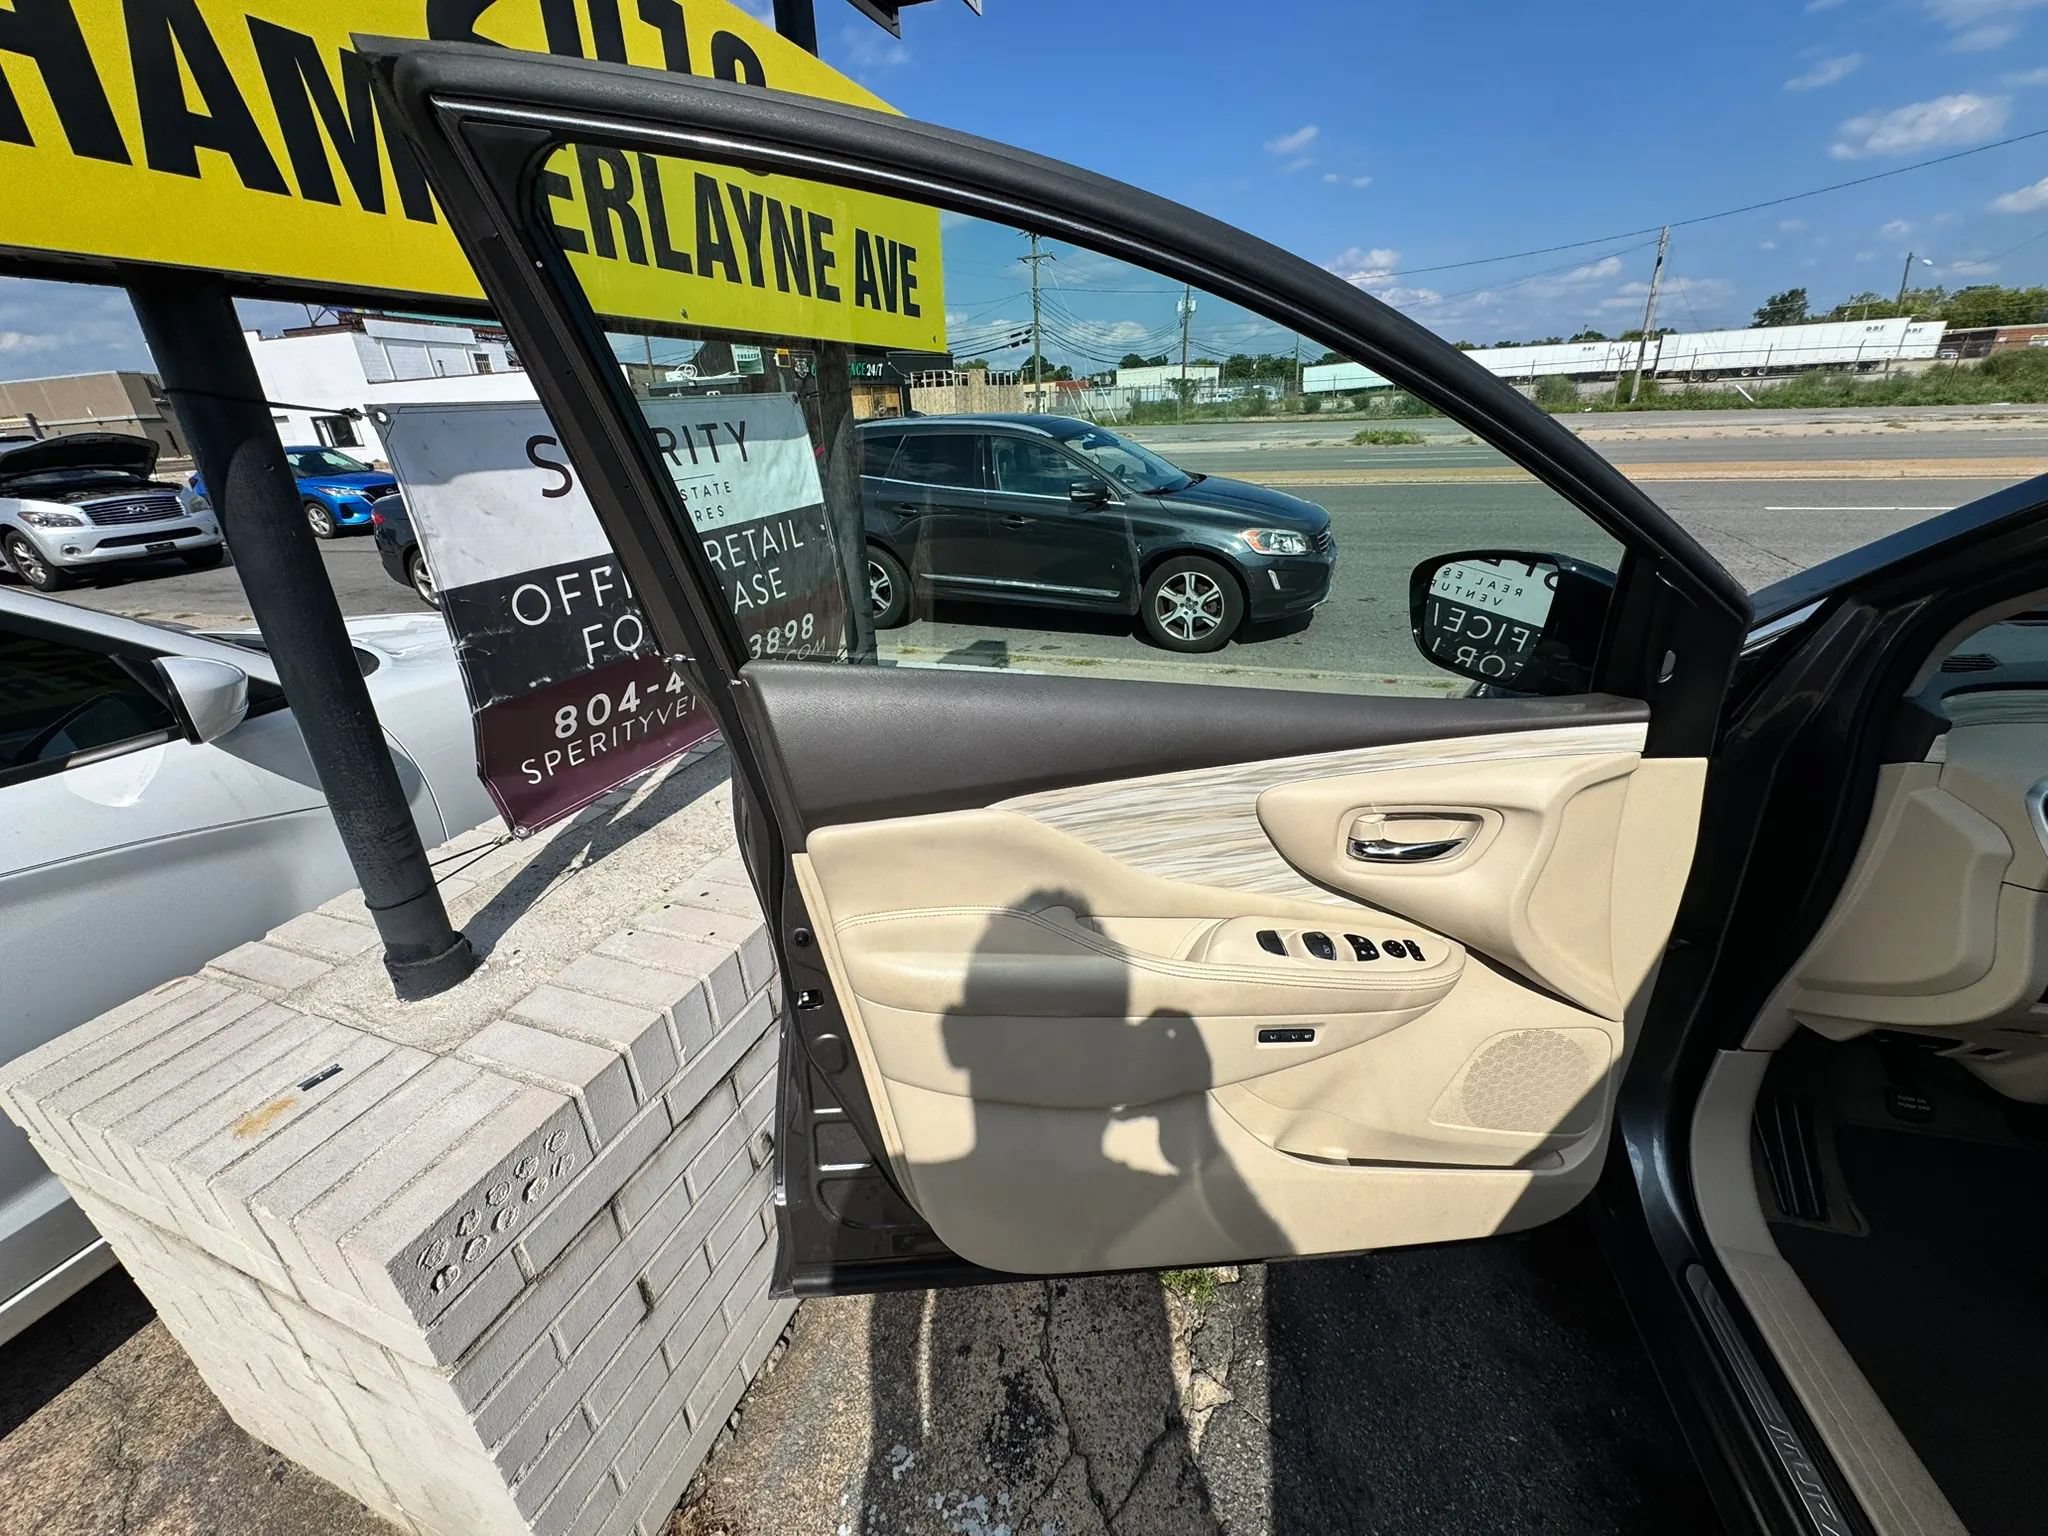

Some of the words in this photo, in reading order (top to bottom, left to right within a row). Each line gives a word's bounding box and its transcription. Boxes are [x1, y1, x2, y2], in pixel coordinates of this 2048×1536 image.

[855, 228, 921, 318] AVE
[866, 363, 883, 377] 24/7
[680, 481, 732, 501] STATE
[694, 504, 725, 522] RES
[511, 565, 633, 626] OFFI
[703, 519, 804, 571] RETAIL
[582, 614, 643, 664] FO
[732, 567, 788, 616] ASE
[749, 612, 815, 661] 3898
